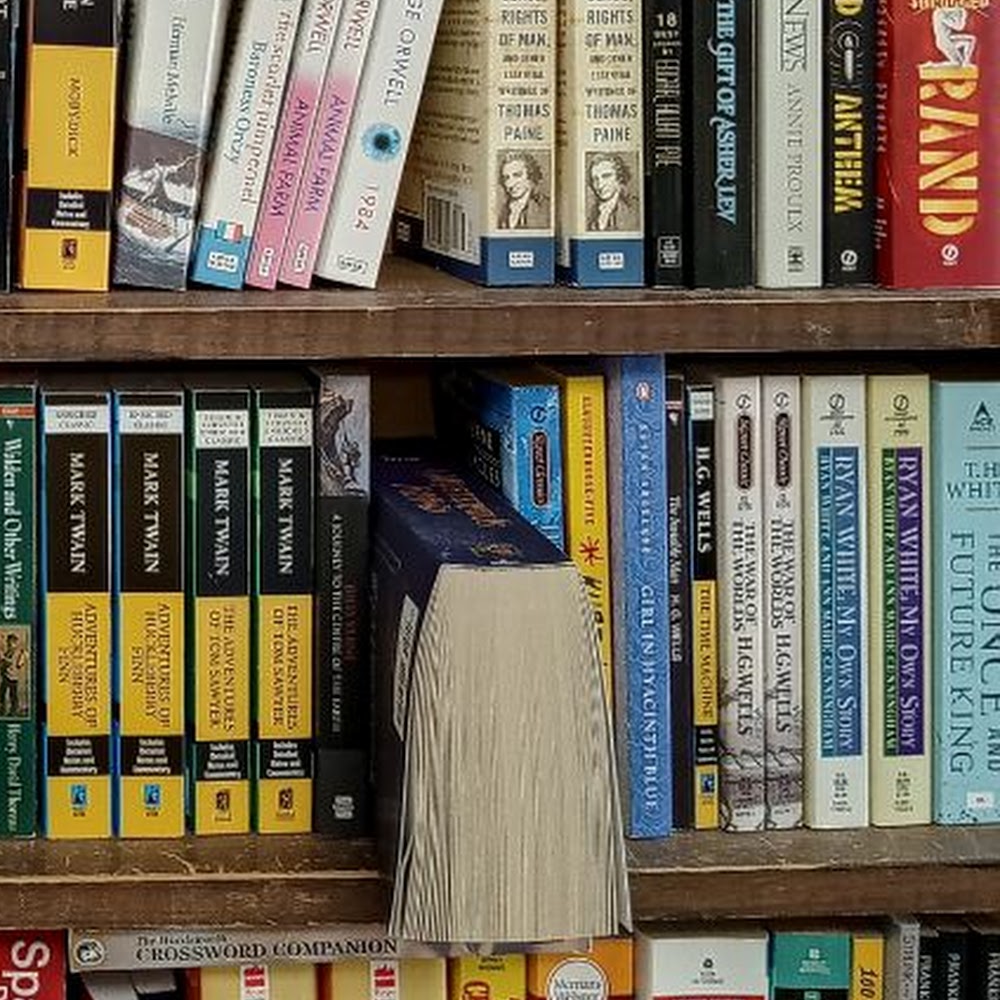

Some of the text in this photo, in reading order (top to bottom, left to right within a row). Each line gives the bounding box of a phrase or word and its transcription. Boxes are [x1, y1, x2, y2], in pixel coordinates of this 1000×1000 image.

[499, 33, 551, 48] OF MAN,
[502, 9, 548, 25] RIGHTS
[384, 27, 416, 107] ORWELL
[497, 103, 551, 118] THOMAS
[504, 125, 544, 141] PAINE
[709, 0, 737, 225] THE GIFT OF ASHER LEV
[832, 92, 864, 213] ANTHEM
[918, 62, 980, 237] RAND
[354, 182, 380, 233] 1984
[142, 450, 160, 574] MARK TWAIN
[695, 445, 712, 554] H.G. WELLS
[834, 455, 856, 517] RYAN
[949, 531, 977, 775] FUTURE KING
[136, 940, 399, 962] CROSSWORD COMPANION
